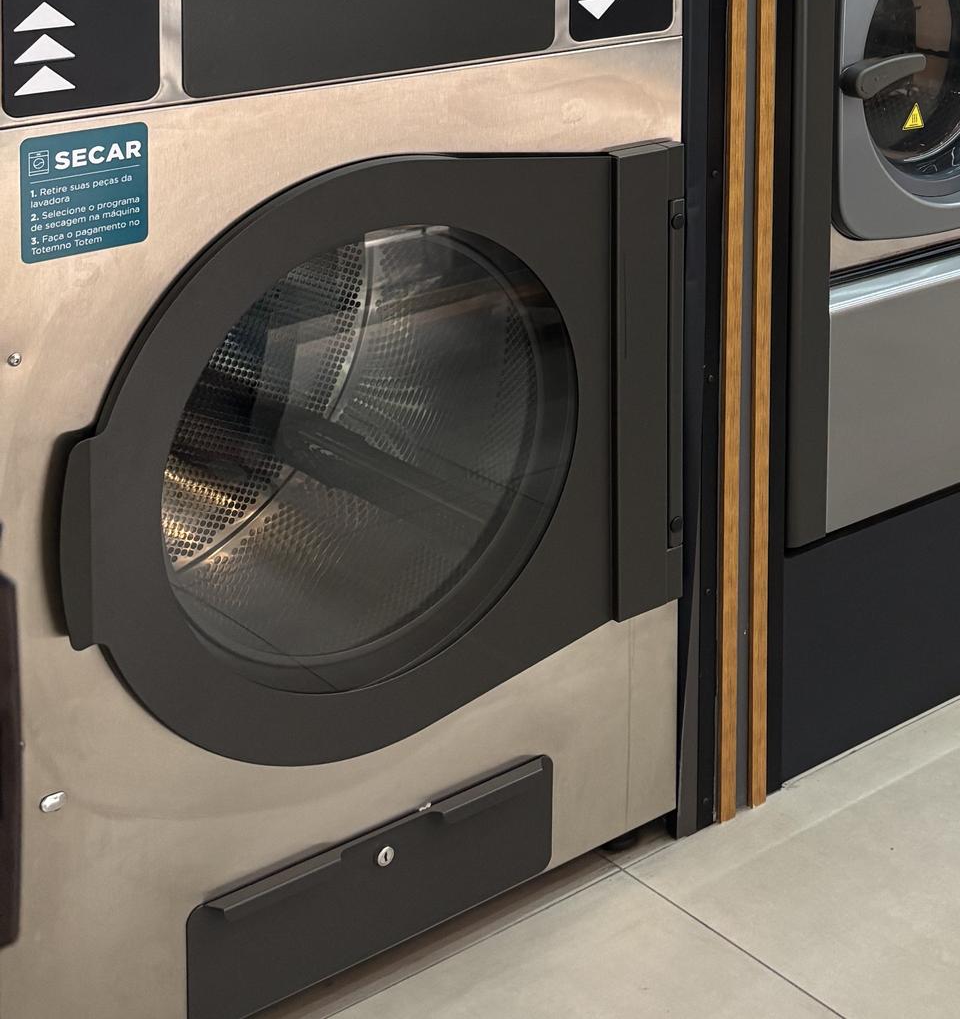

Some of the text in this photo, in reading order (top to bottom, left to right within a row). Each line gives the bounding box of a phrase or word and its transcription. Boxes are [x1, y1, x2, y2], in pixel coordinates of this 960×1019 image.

[54, 140, 142, 170] SECAR
[30, 174, 132, 198] 1. Retire suas peças da
[30, 196, 70, 209] lavadora
[30, 213, 39, 222] 2.
[42, 206, 86, 220] Selecione
[97, 196, 140, 211] programa
[30, 207, 140, 232] de secagem na máquina
[30, 219, 140, 245] 3. Faça o pagamento no
[31, 235, 102, 255] Totemno Totem
